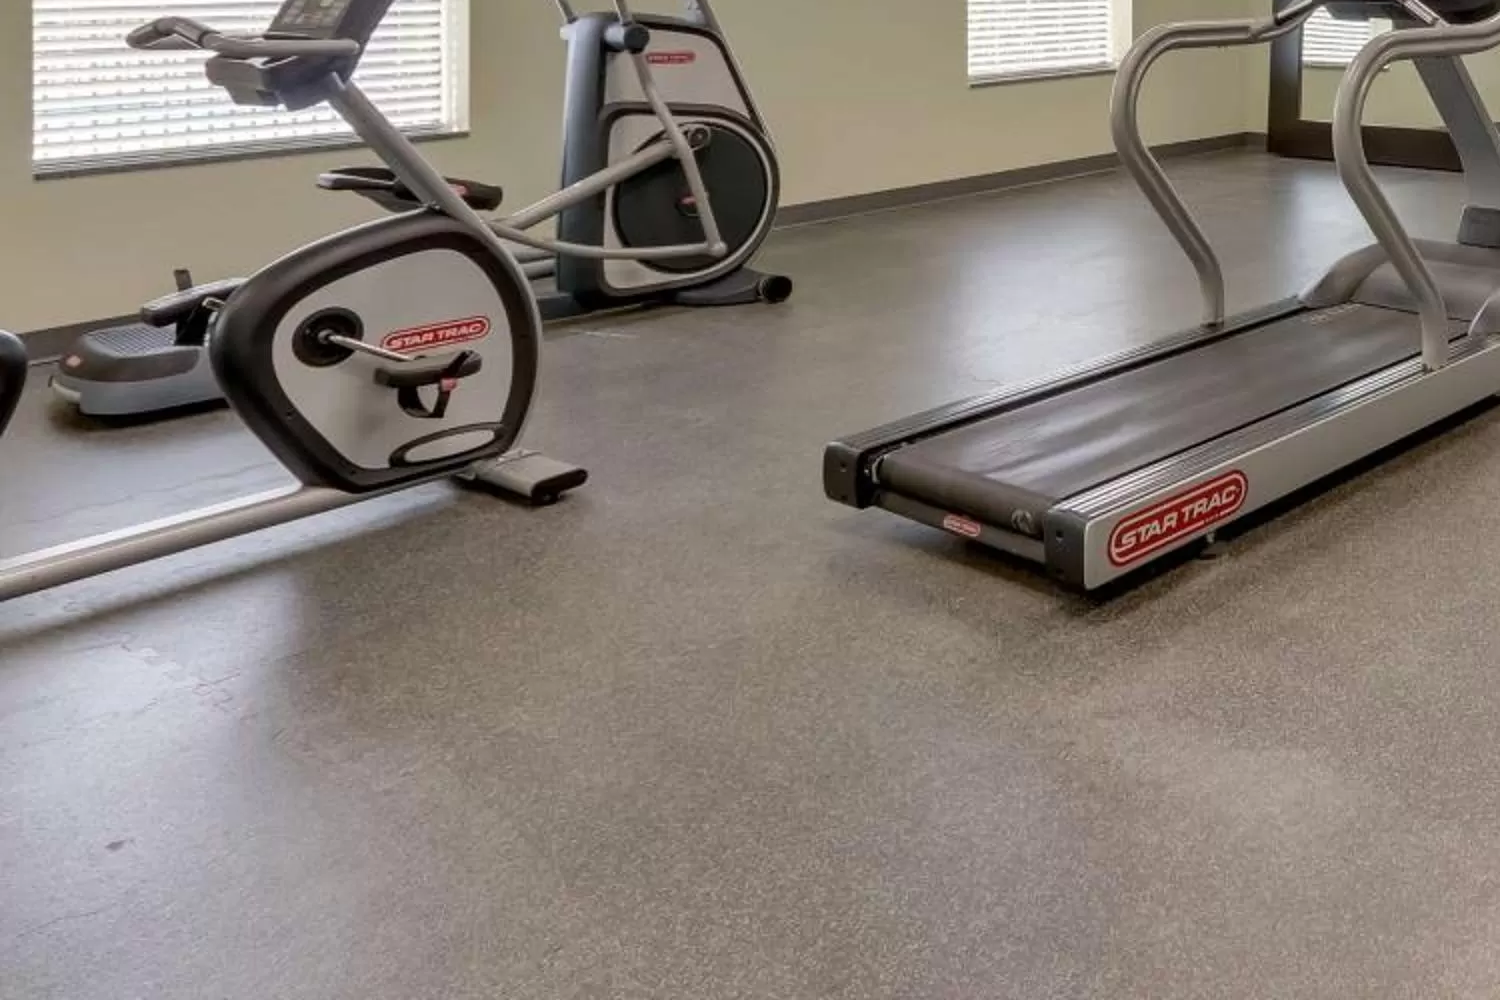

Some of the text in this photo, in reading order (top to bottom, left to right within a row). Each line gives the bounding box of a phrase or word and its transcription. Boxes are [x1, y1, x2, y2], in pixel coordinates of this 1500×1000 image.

[390, 323, 482, 349] STAR TRAC
[1121, 485, 1237, 548] STAR TRAC
